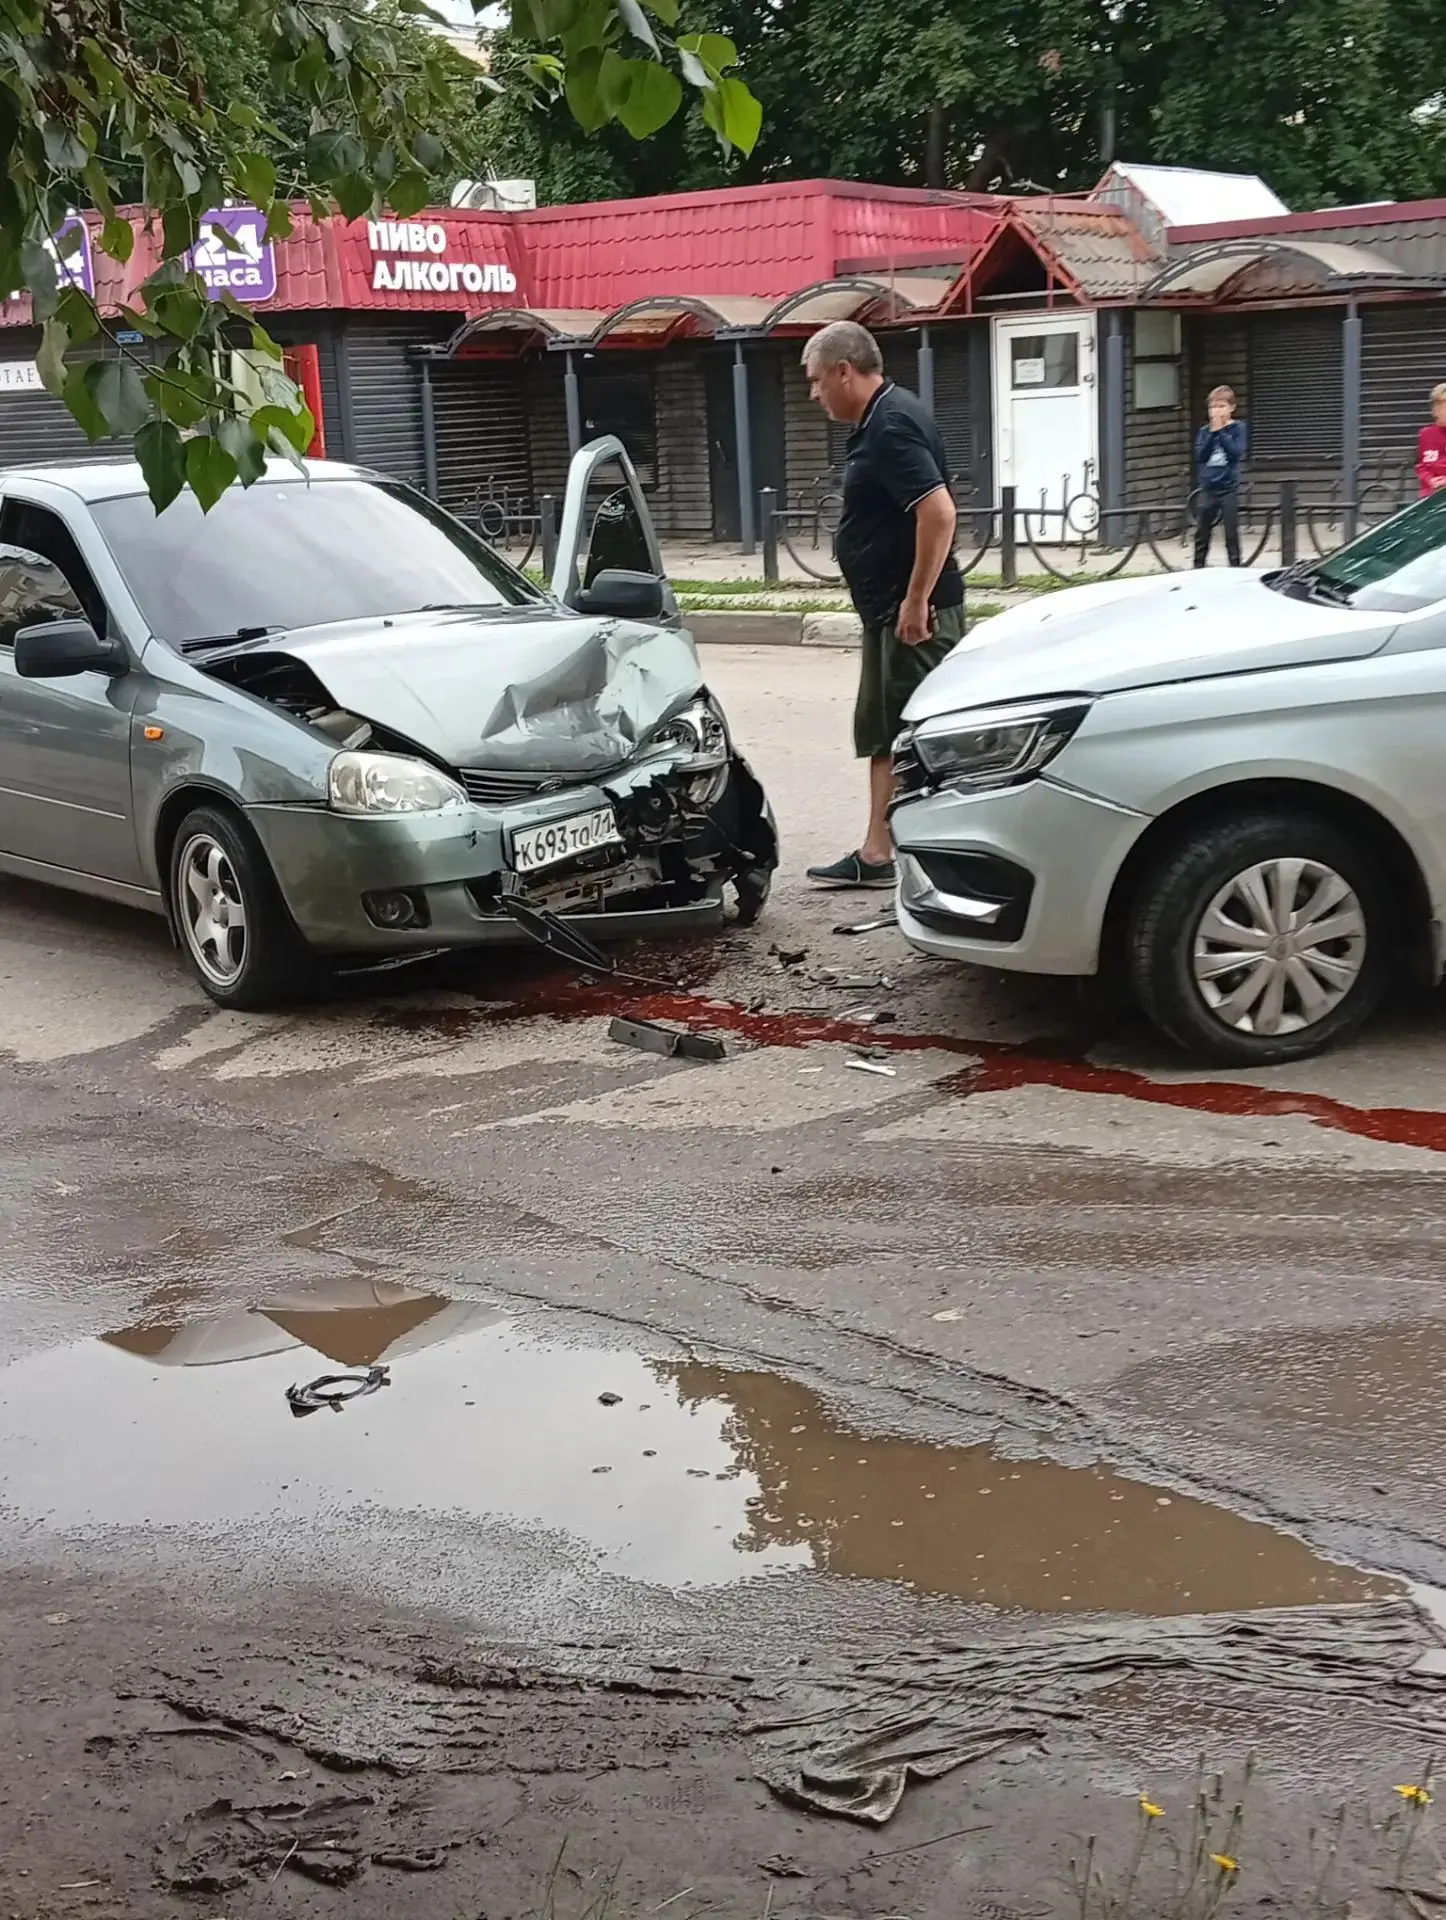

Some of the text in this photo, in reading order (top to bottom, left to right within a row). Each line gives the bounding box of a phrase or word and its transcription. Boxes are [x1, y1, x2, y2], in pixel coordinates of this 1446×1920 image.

[195, 224, 264, 267] 24
[367, 220, 447, 254] ПИВО
[372, 260, 517, 293] АЛКОГОЛЬ
